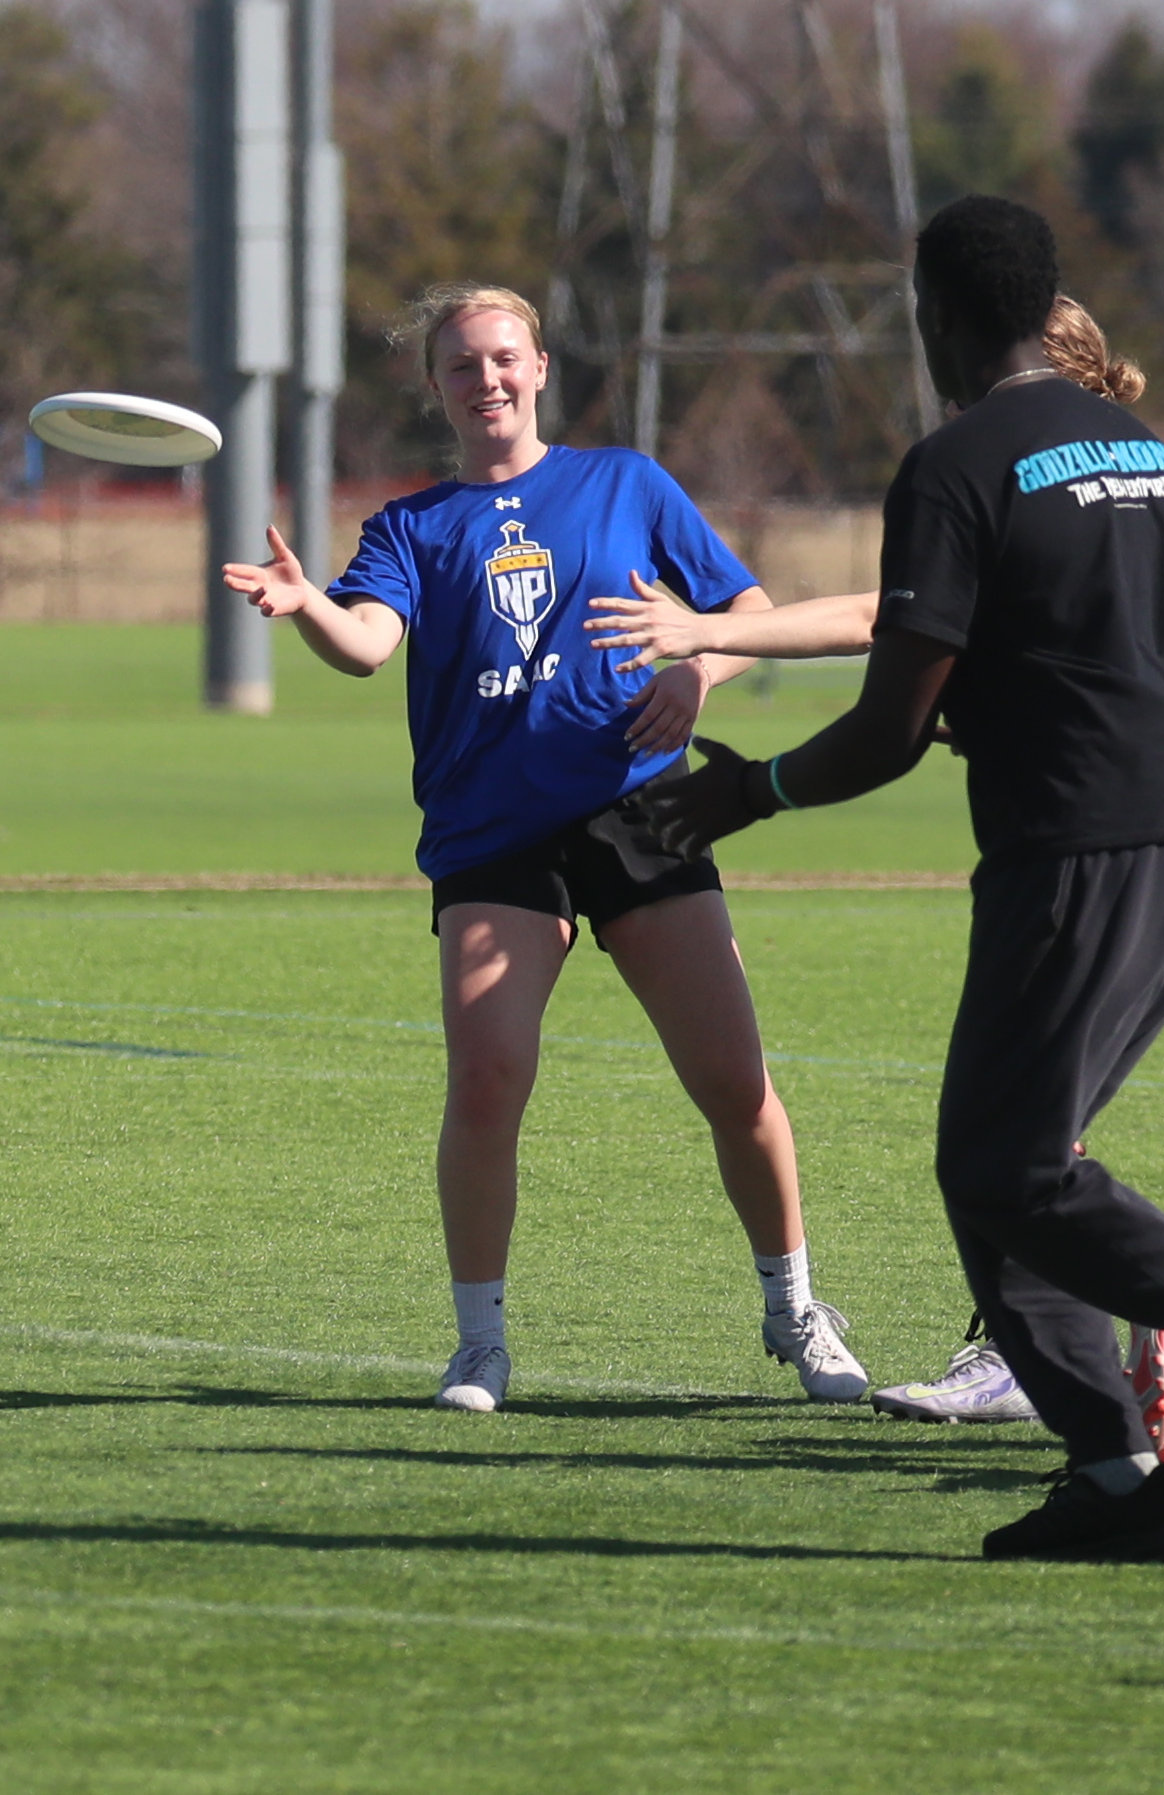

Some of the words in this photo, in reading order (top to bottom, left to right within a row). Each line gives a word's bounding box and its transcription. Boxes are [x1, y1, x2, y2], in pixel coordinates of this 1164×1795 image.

[1014, 440, 1118, 494] GODZILLA
[1066, 481, 1107, 508] THE
[495, 569, 547, 622] NP
